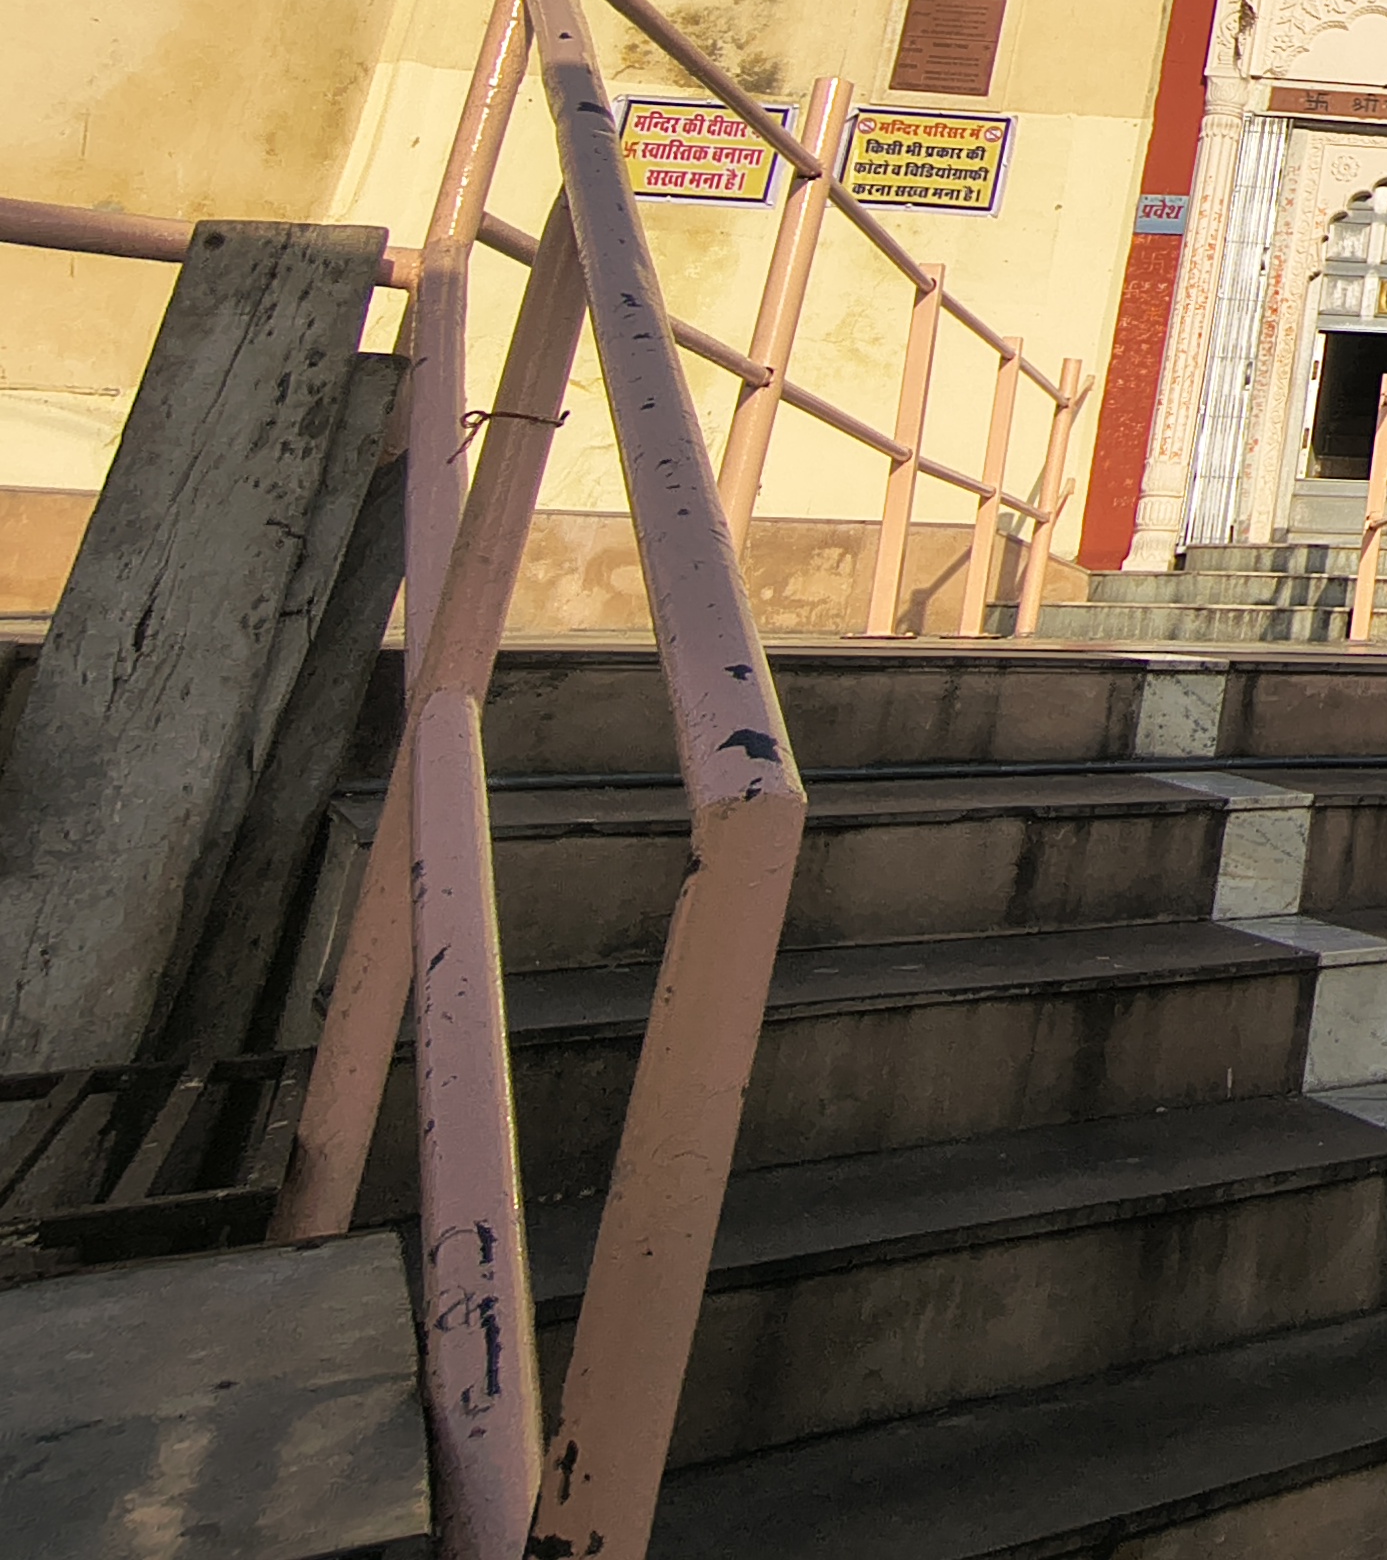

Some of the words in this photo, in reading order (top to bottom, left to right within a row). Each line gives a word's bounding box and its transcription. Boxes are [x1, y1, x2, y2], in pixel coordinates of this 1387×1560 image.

[1352, 93, 1380, 113] श्री
[634, 111, 681, 134] मन्दिर
[682, 113, 705, 136] की
[707, 115, 748, 138] दीवार
[879, 119, 921, 136] मन्दिर
[923, 122, 967, 139] परिसर
[641, 139, 709, 162] स्वास्तिक
[712, 146, 764, 166] बनाना
[865, 139, 902, 155] किसी
[905, 142, 922, 157] भी
[924, 147, 963, 159] प्रकार
[966, 145, 986, 161] की
[646, 169, 689, 188] सख्त
[689, 172, 724, 190] मना
[891, 165, 903, 176] व
[852, 182, 892, 196] करना
[894, 185, 929, 198] सख्त
[932, 188, 961, 201] मना
[1139, 197, 1184, 219] प्रवेश
